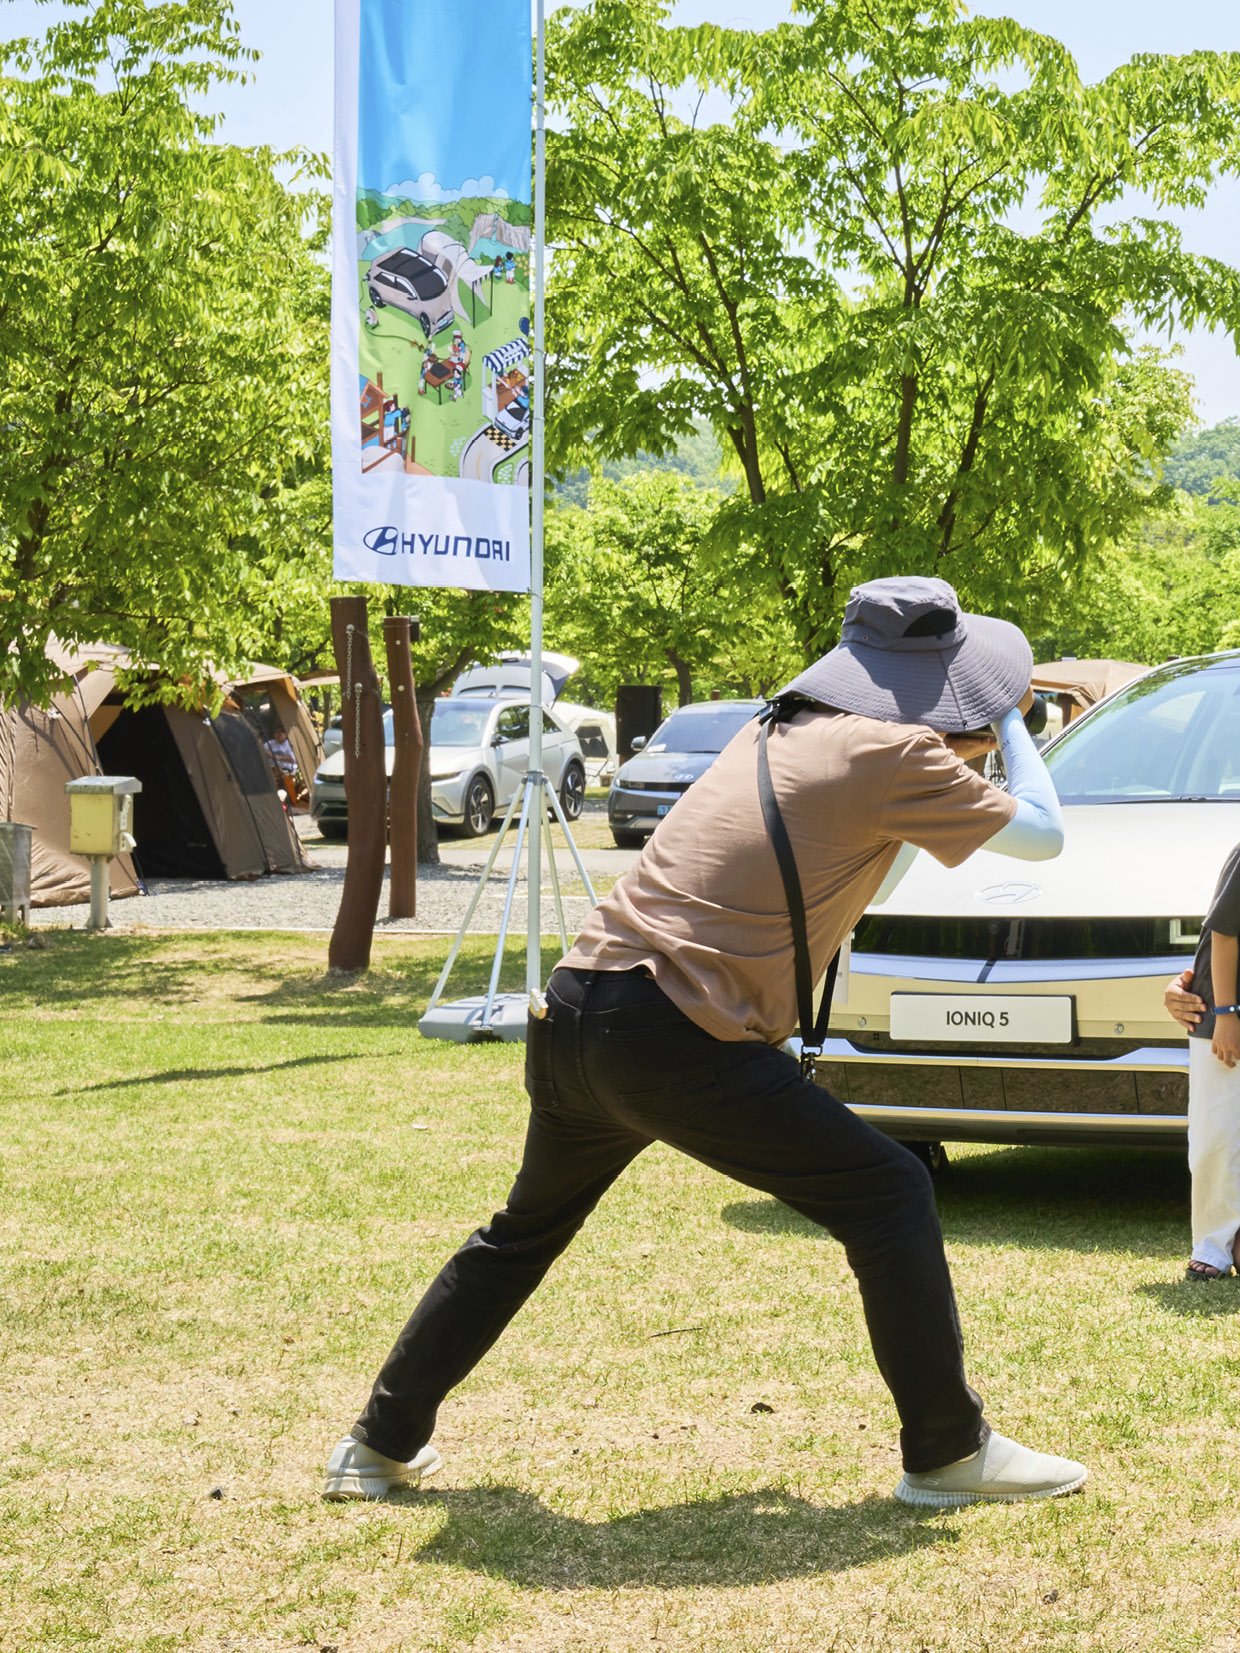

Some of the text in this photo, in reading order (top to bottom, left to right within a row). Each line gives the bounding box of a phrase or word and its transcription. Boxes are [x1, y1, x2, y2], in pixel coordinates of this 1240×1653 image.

[401, 532, 511, 562] HYUNDAI
[946, 1011, 1009, 1028] IONIQ 5
